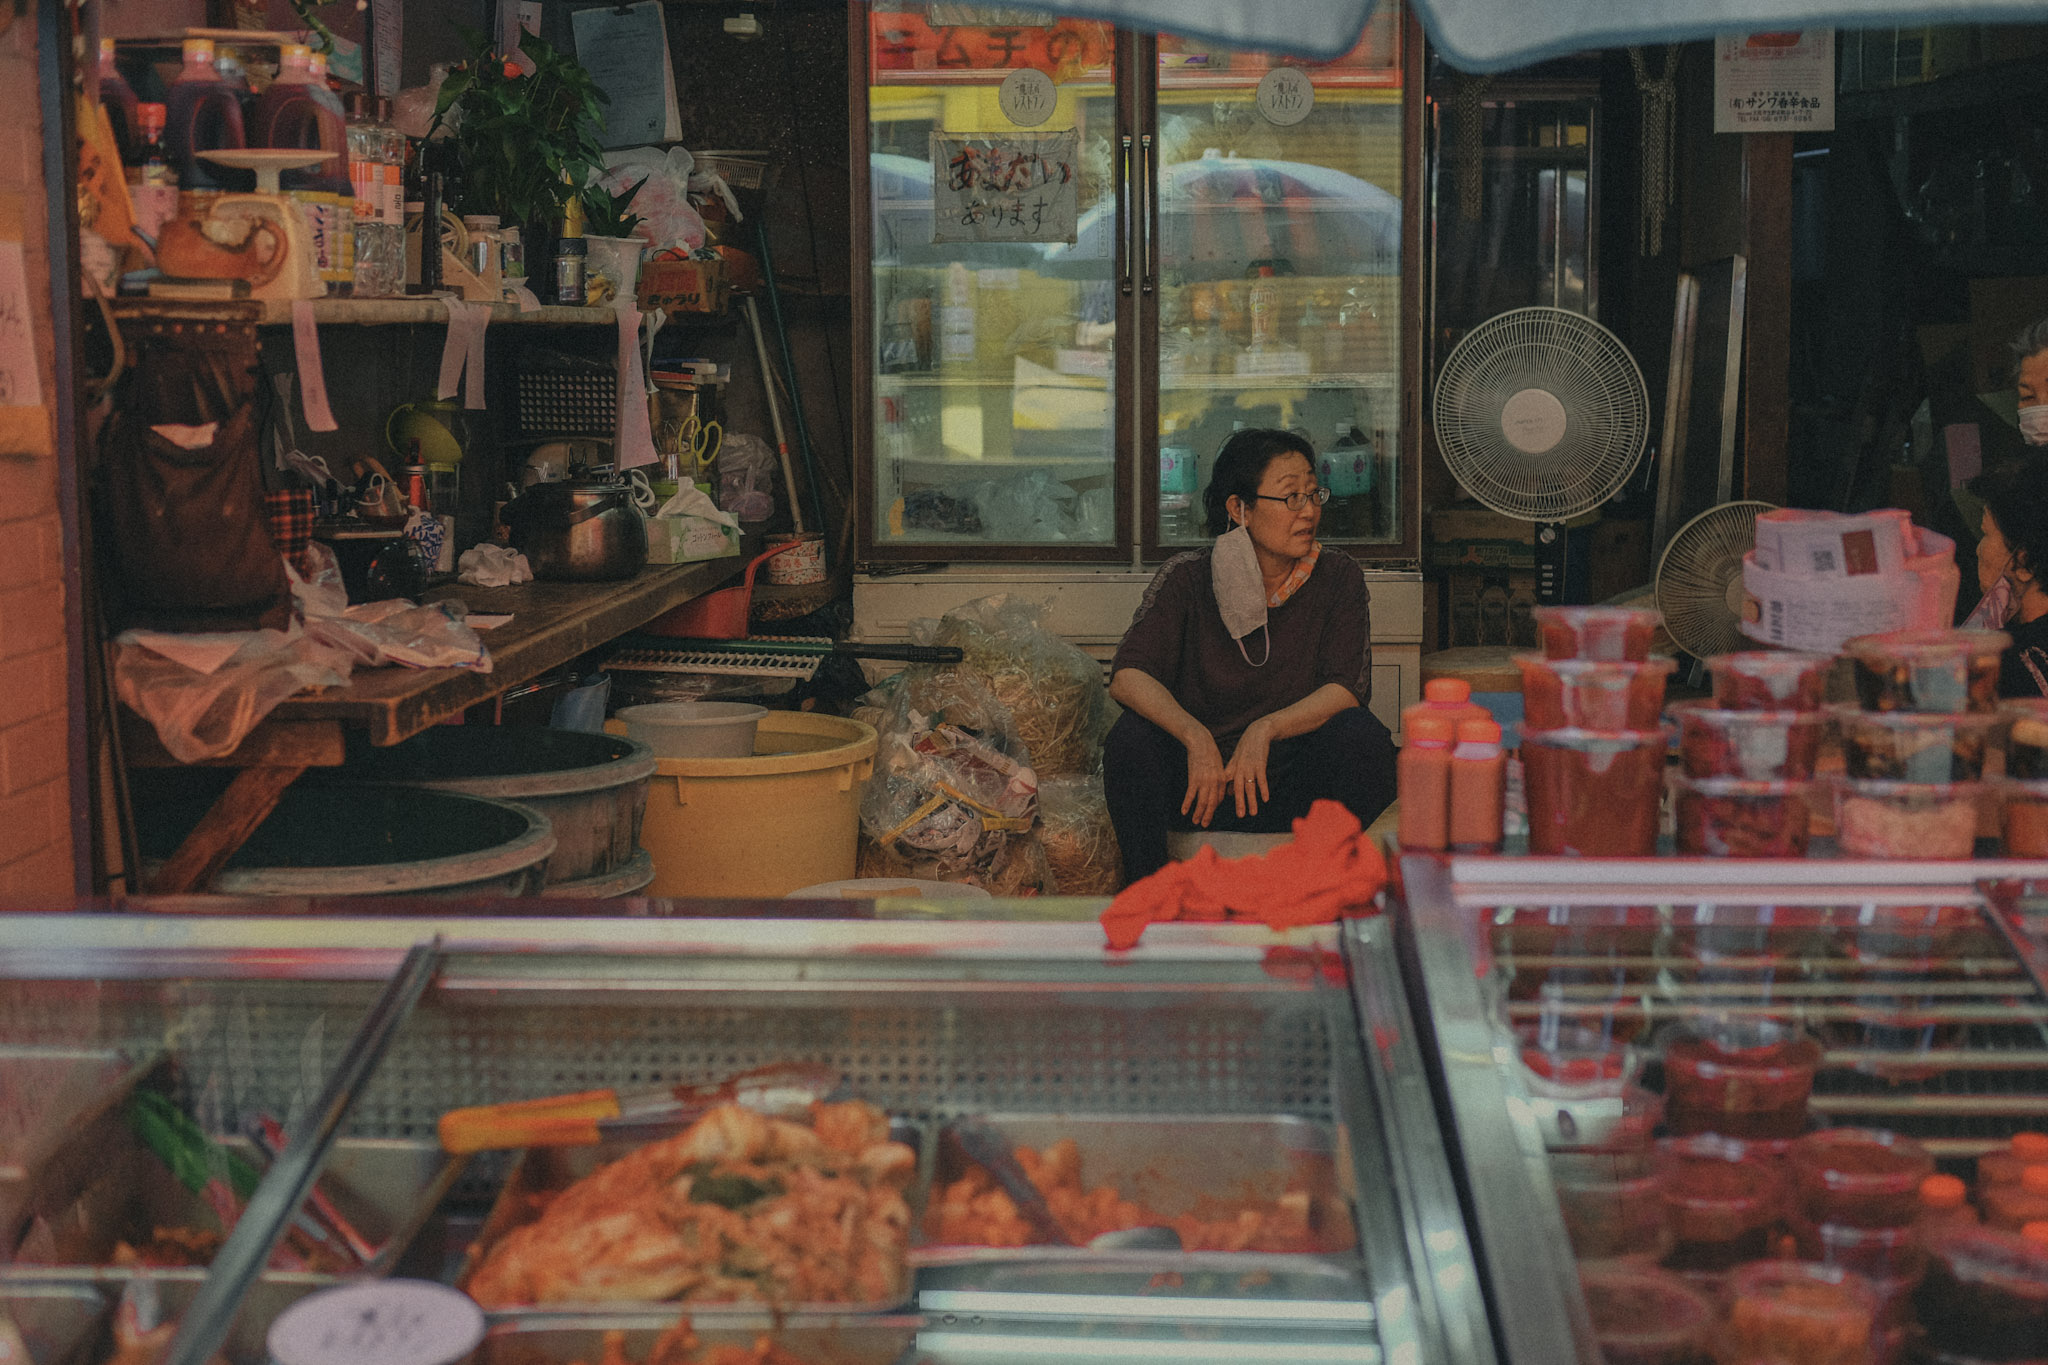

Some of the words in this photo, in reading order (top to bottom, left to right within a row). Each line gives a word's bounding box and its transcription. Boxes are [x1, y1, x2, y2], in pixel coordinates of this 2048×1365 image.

[961, 196, 1048, 235] あります
[648, 293, 700, 305] きゅうり
